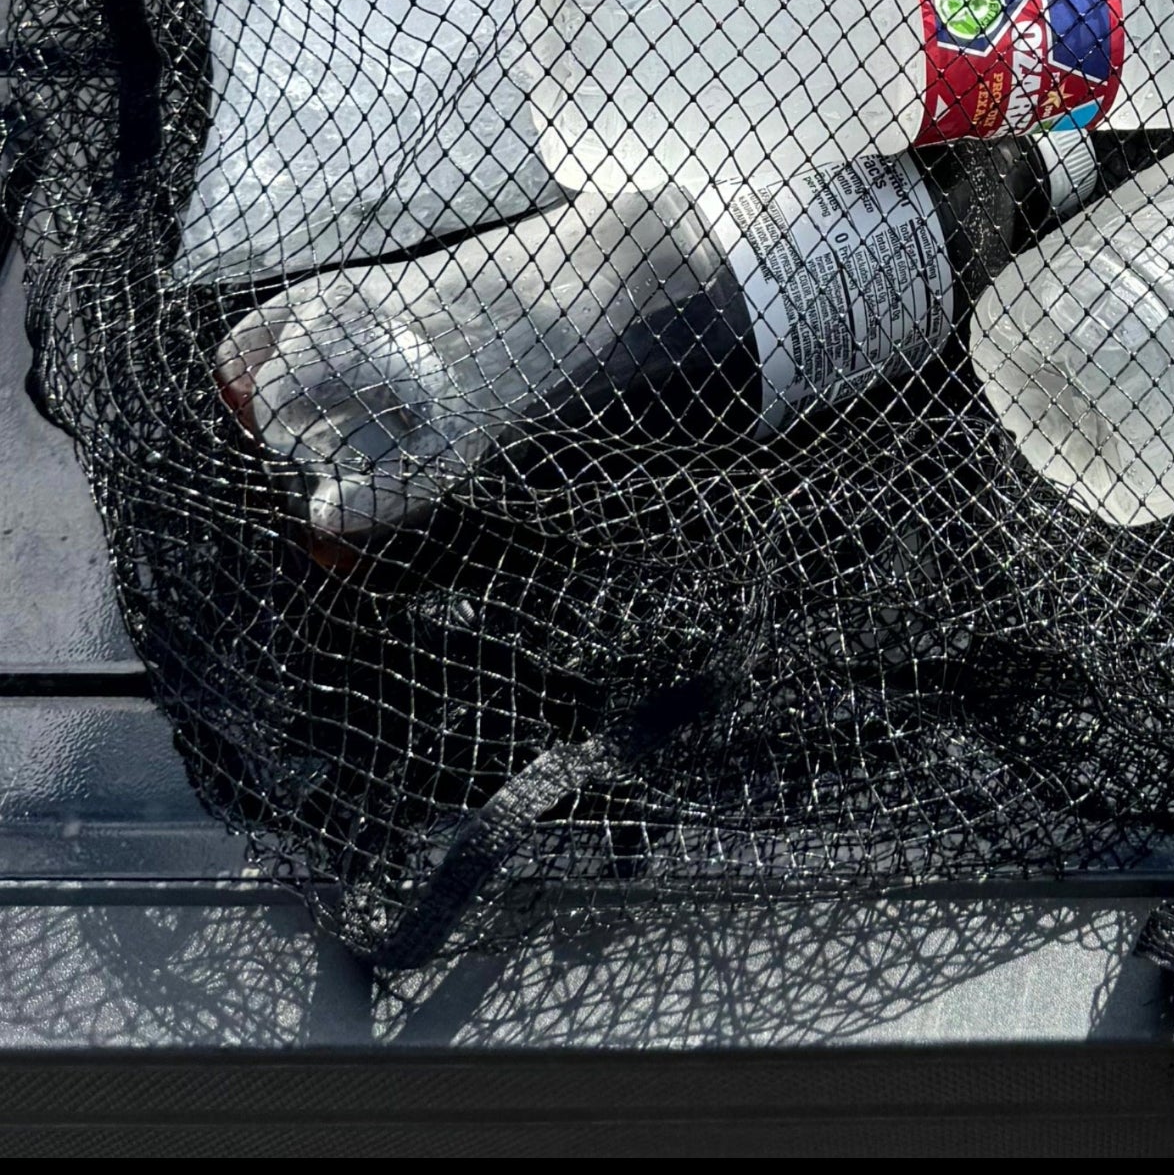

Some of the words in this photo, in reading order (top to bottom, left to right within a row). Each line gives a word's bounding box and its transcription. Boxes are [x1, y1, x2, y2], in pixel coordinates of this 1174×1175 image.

[859, 193, 875, 214] size
[833, 231, 850, 244] 0
[874, 230, 888, 254] Total
